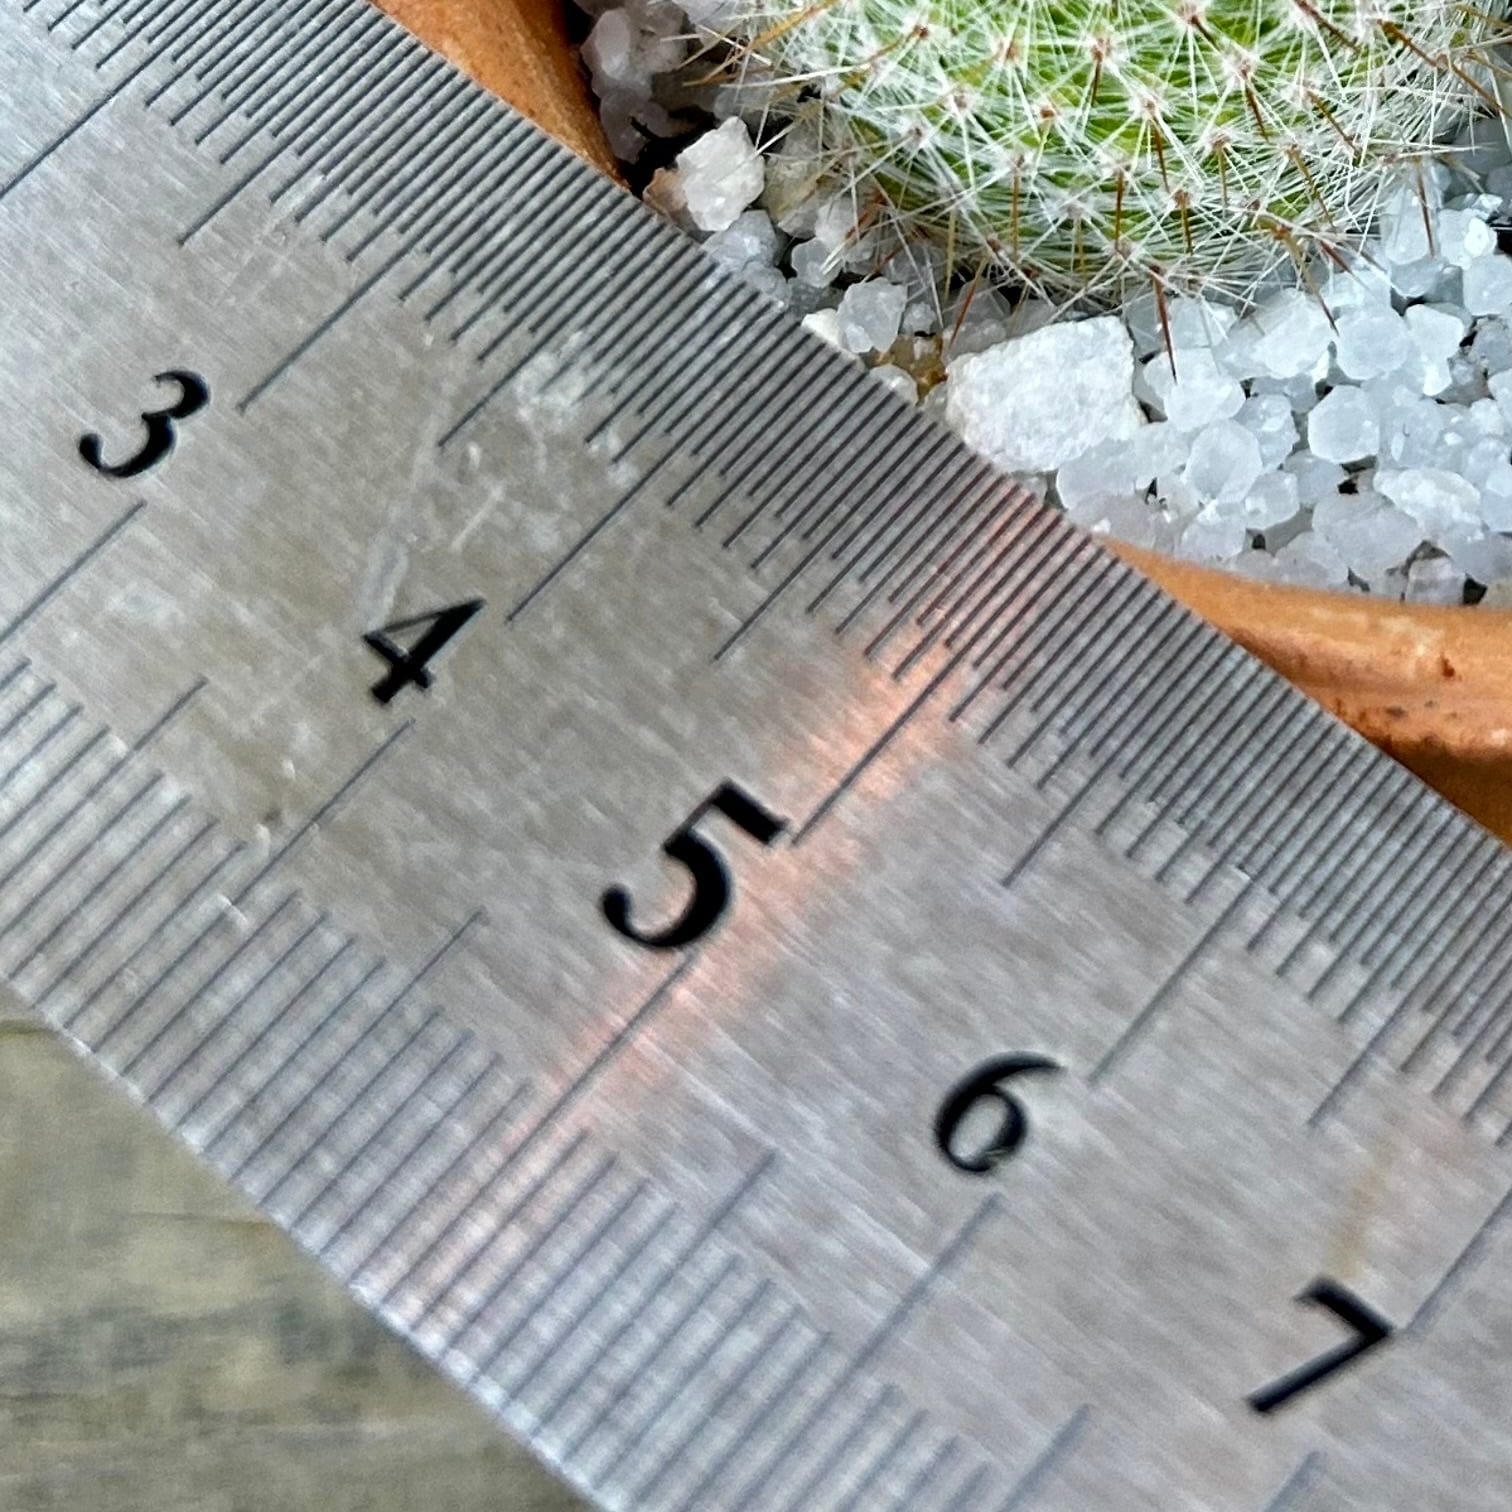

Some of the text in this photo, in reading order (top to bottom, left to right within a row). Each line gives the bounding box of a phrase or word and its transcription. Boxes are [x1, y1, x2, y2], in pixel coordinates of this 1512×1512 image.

[78, 369, 1394, 1415] 3 4 5 6 7
